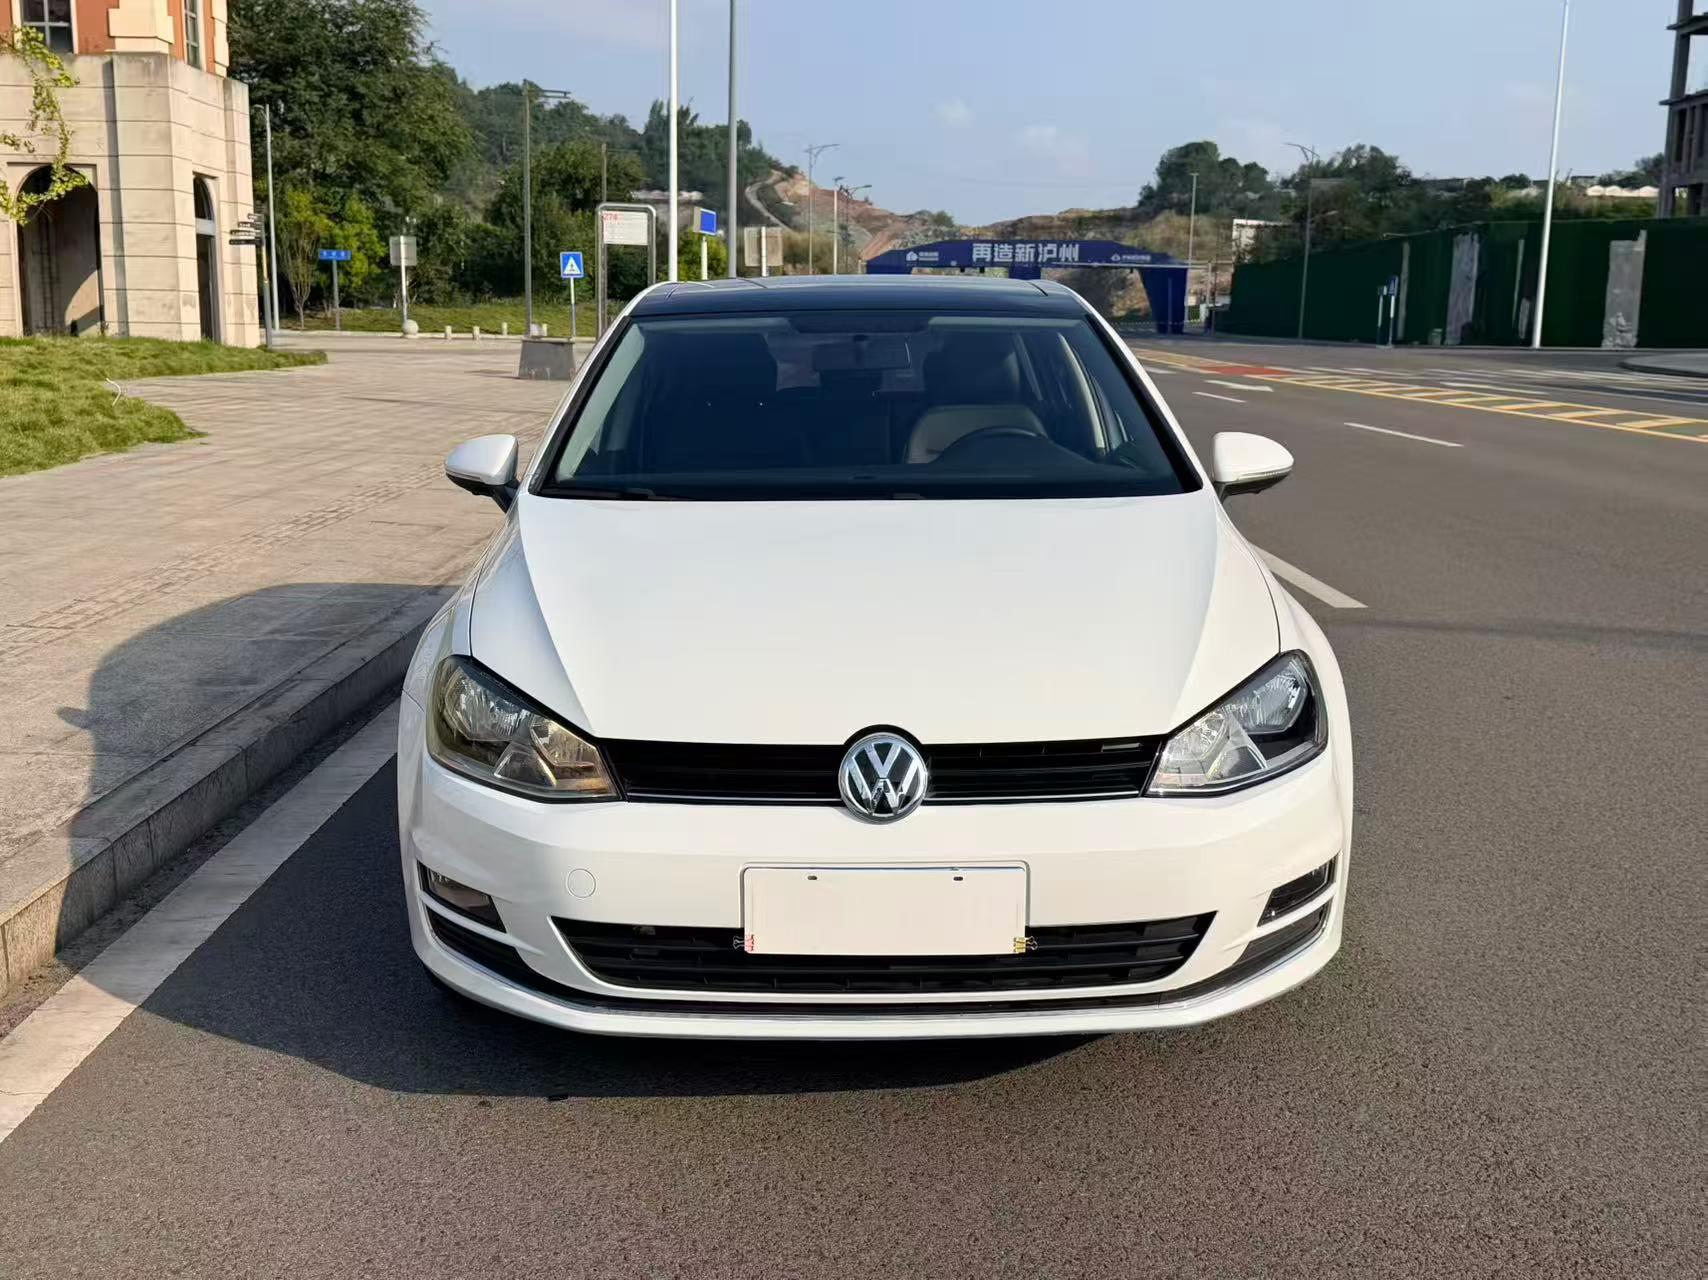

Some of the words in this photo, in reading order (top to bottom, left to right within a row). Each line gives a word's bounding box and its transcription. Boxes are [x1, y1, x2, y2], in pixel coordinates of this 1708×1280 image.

[972, 243, 1079, 262] 再造新泸州
[842, 736, 923, 820] VW
